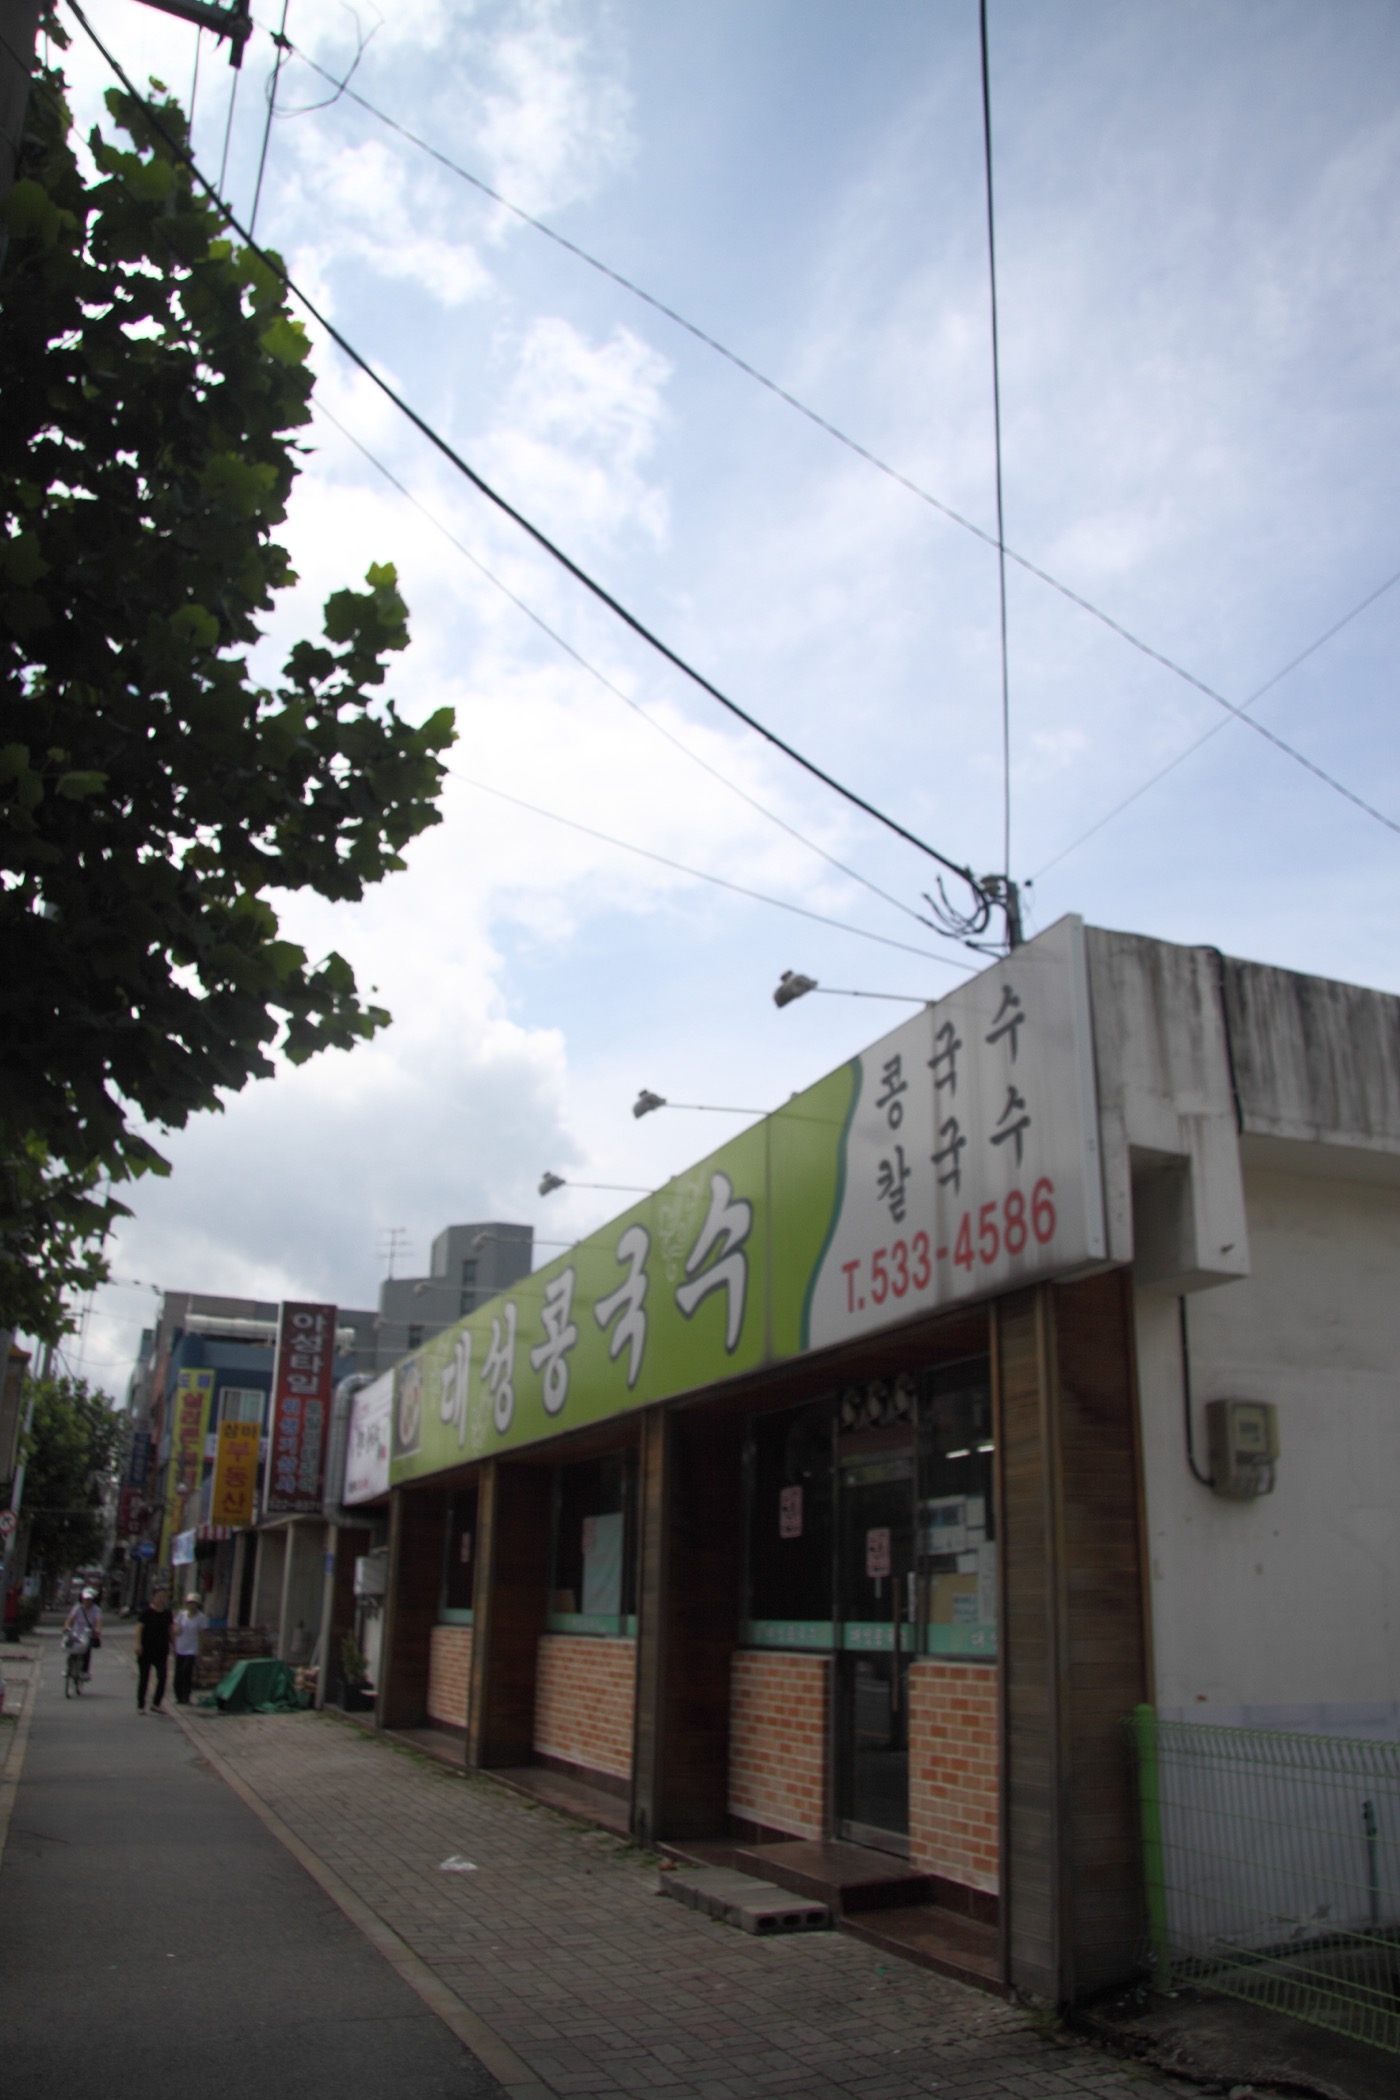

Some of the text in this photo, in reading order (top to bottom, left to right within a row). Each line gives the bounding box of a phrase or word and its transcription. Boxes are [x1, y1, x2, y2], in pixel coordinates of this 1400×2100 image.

[875, 984, 1026, 1130] 콩국수
[876, 1085, 1031, 1223] 칼국수
[440, 1170, 753, 1450] 대성콩국수
[841, 1177, 1057, 1313] T.533-4586
[222, 1442, 252, 1514] 부동산
